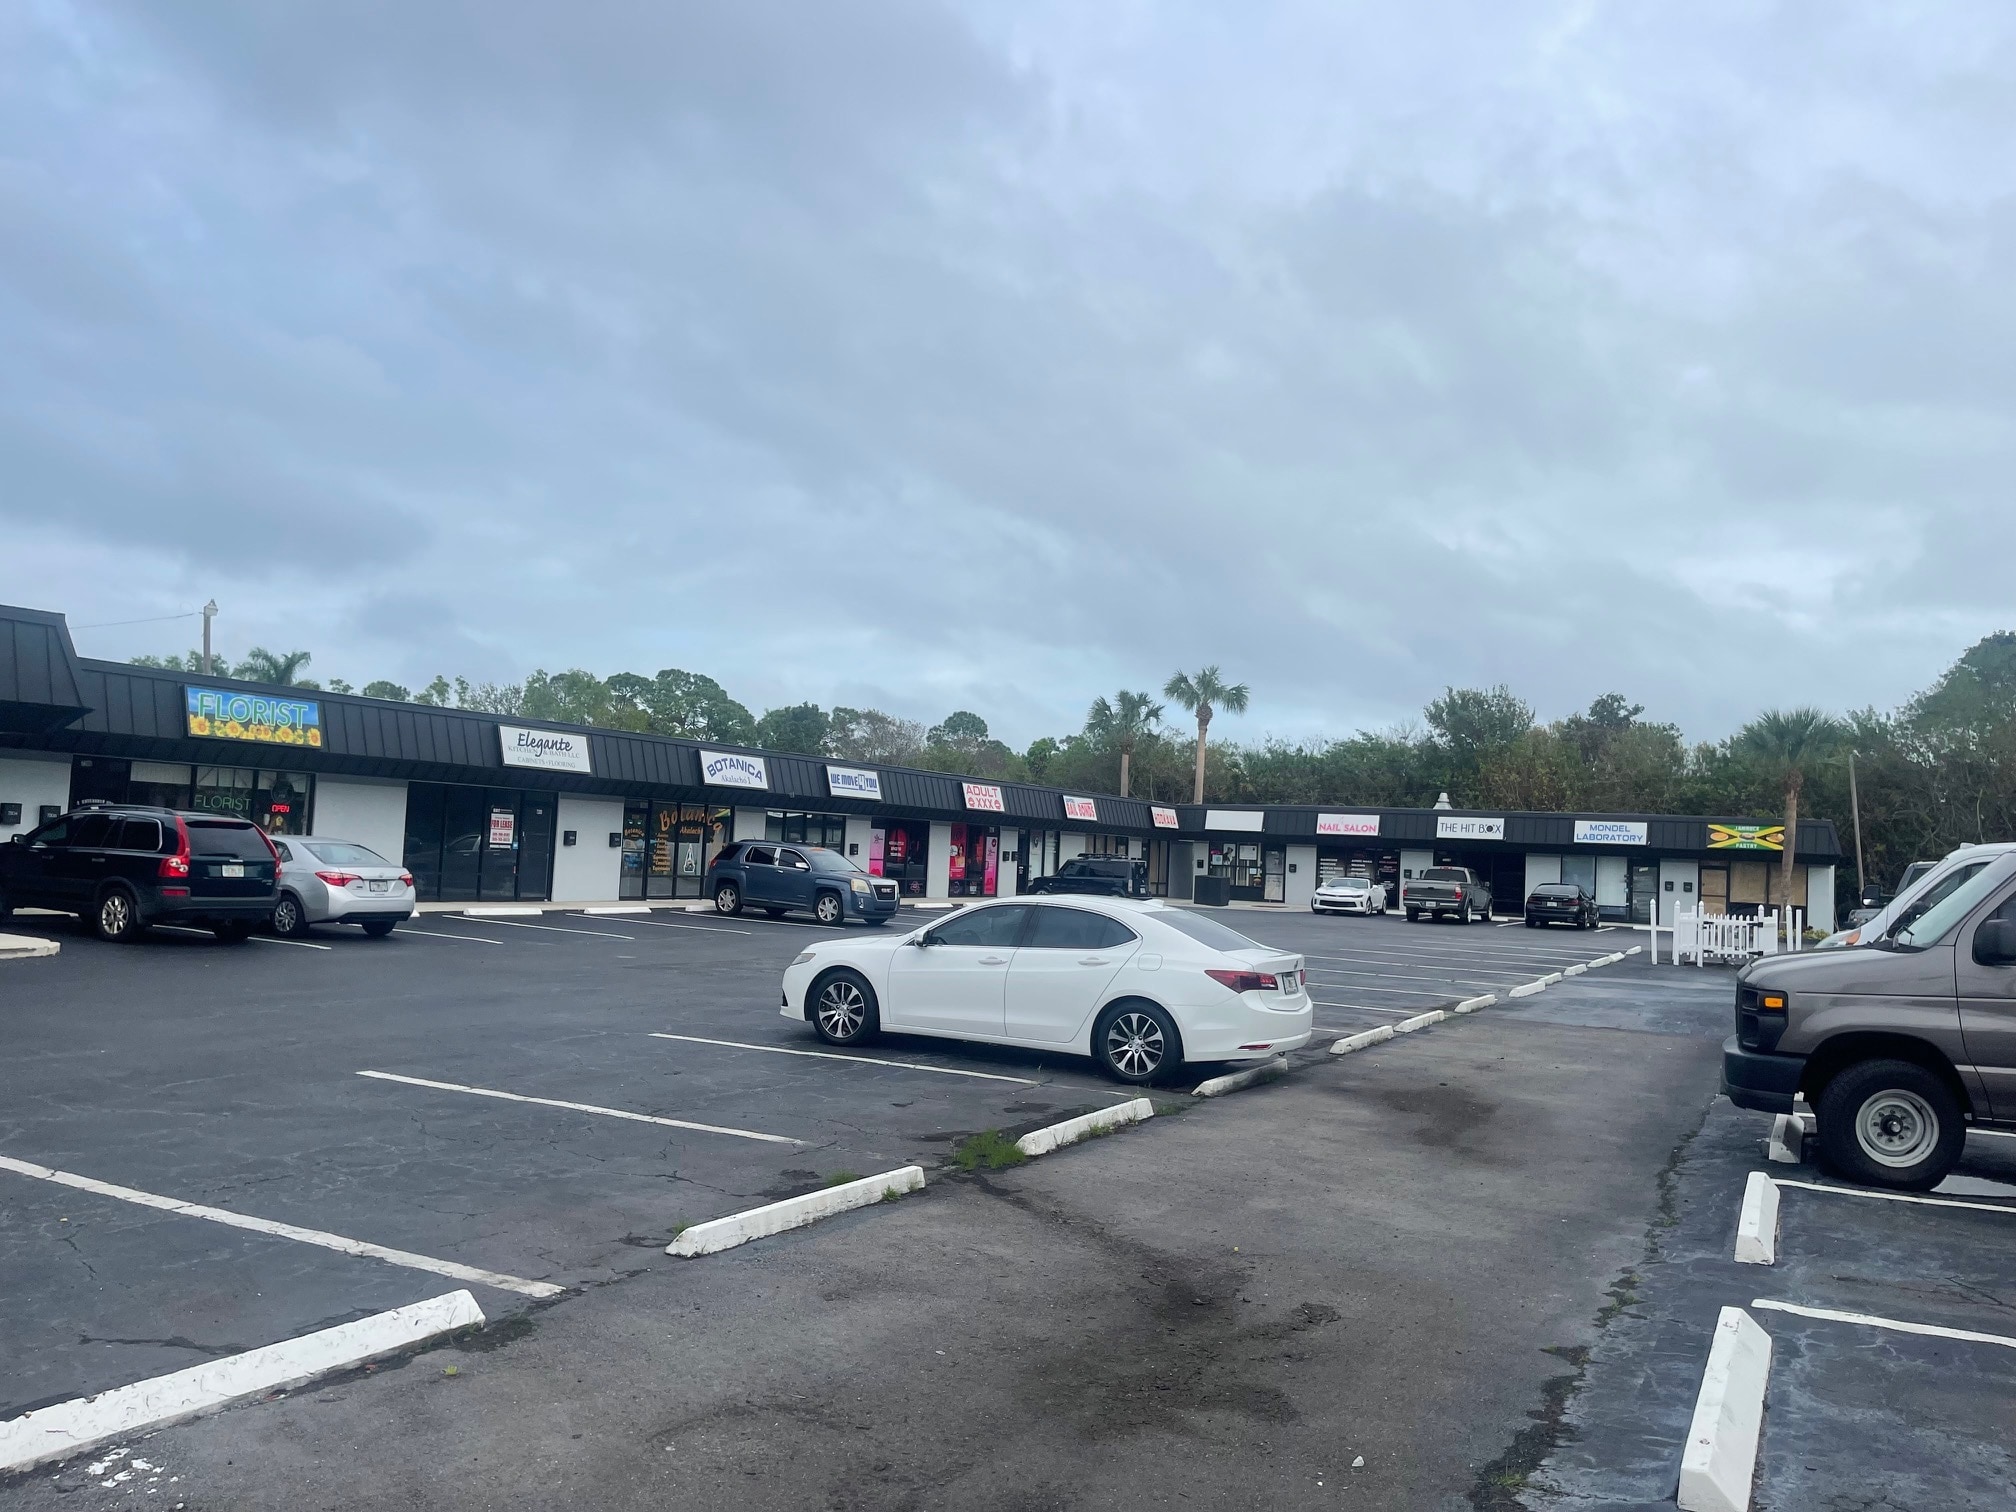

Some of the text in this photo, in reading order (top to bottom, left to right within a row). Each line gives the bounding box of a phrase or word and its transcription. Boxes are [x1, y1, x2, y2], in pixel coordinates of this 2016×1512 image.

[198, 692, 309, 729] FLORIST
[508, 746, 538, 754] KITCHEN
[517, 731, 573, 757] Elegante
[517, 756, 576, 769] CABINETS FLOORING
[706, 757, 763, 783] BOTANICA
[830, 773, 841, 784] WE
[865, 777, 877, 789] YOU
[966, 784, 998, 798] ADULT
[193, 794, 252, 810] FLORIST
[975, 797, 994, 809] XXX
[271, 804, 290, 813] OPEN
[1319, 824, 1377, 833] NAIL SALON
[1440, 822, 1458, 833] THE
[1460, 823, 1476, 833] HIT
[1589, 824, 1631, 833] MONDEL
[1576, 833, 1643, 842] LABORATORY
